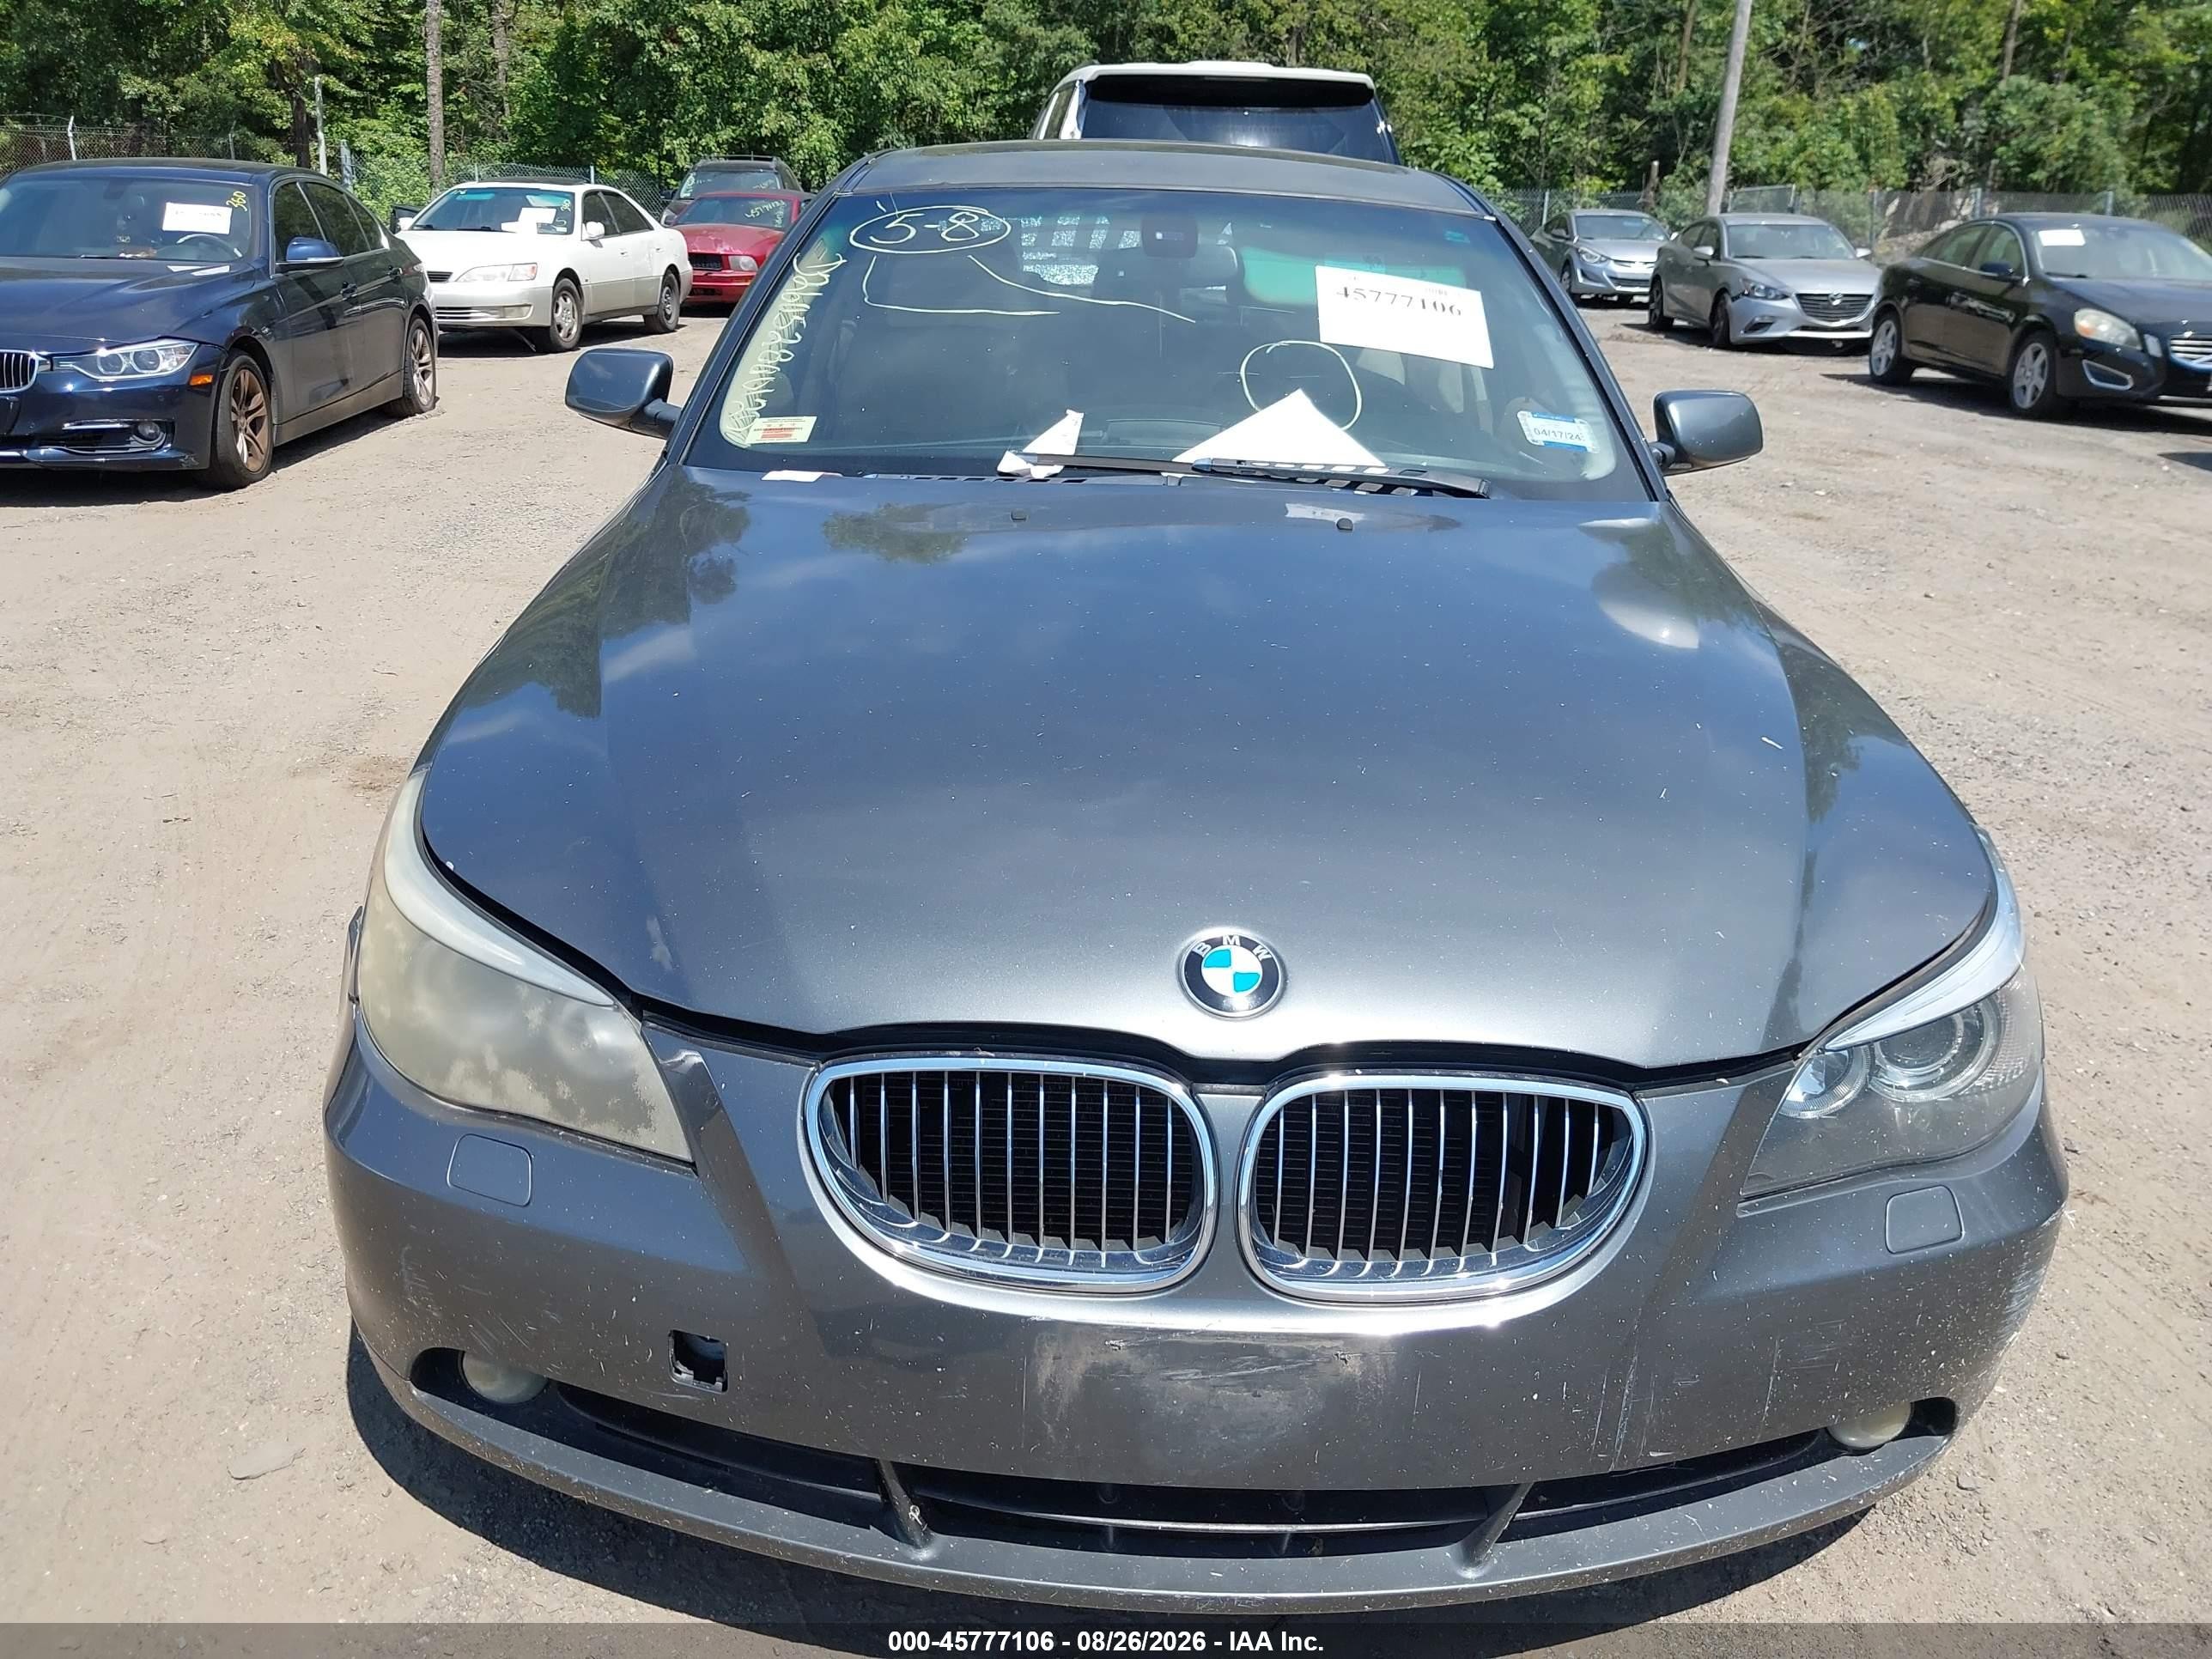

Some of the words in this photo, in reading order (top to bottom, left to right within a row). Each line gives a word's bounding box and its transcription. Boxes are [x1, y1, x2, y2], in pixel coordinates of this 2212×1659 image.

[226, 191, 248, 212] 360
[868, 211, 980, 245] 5-8
[1336, 286, 1462, 316] 45777106
[1192, 933, 1273, 962] BMW
